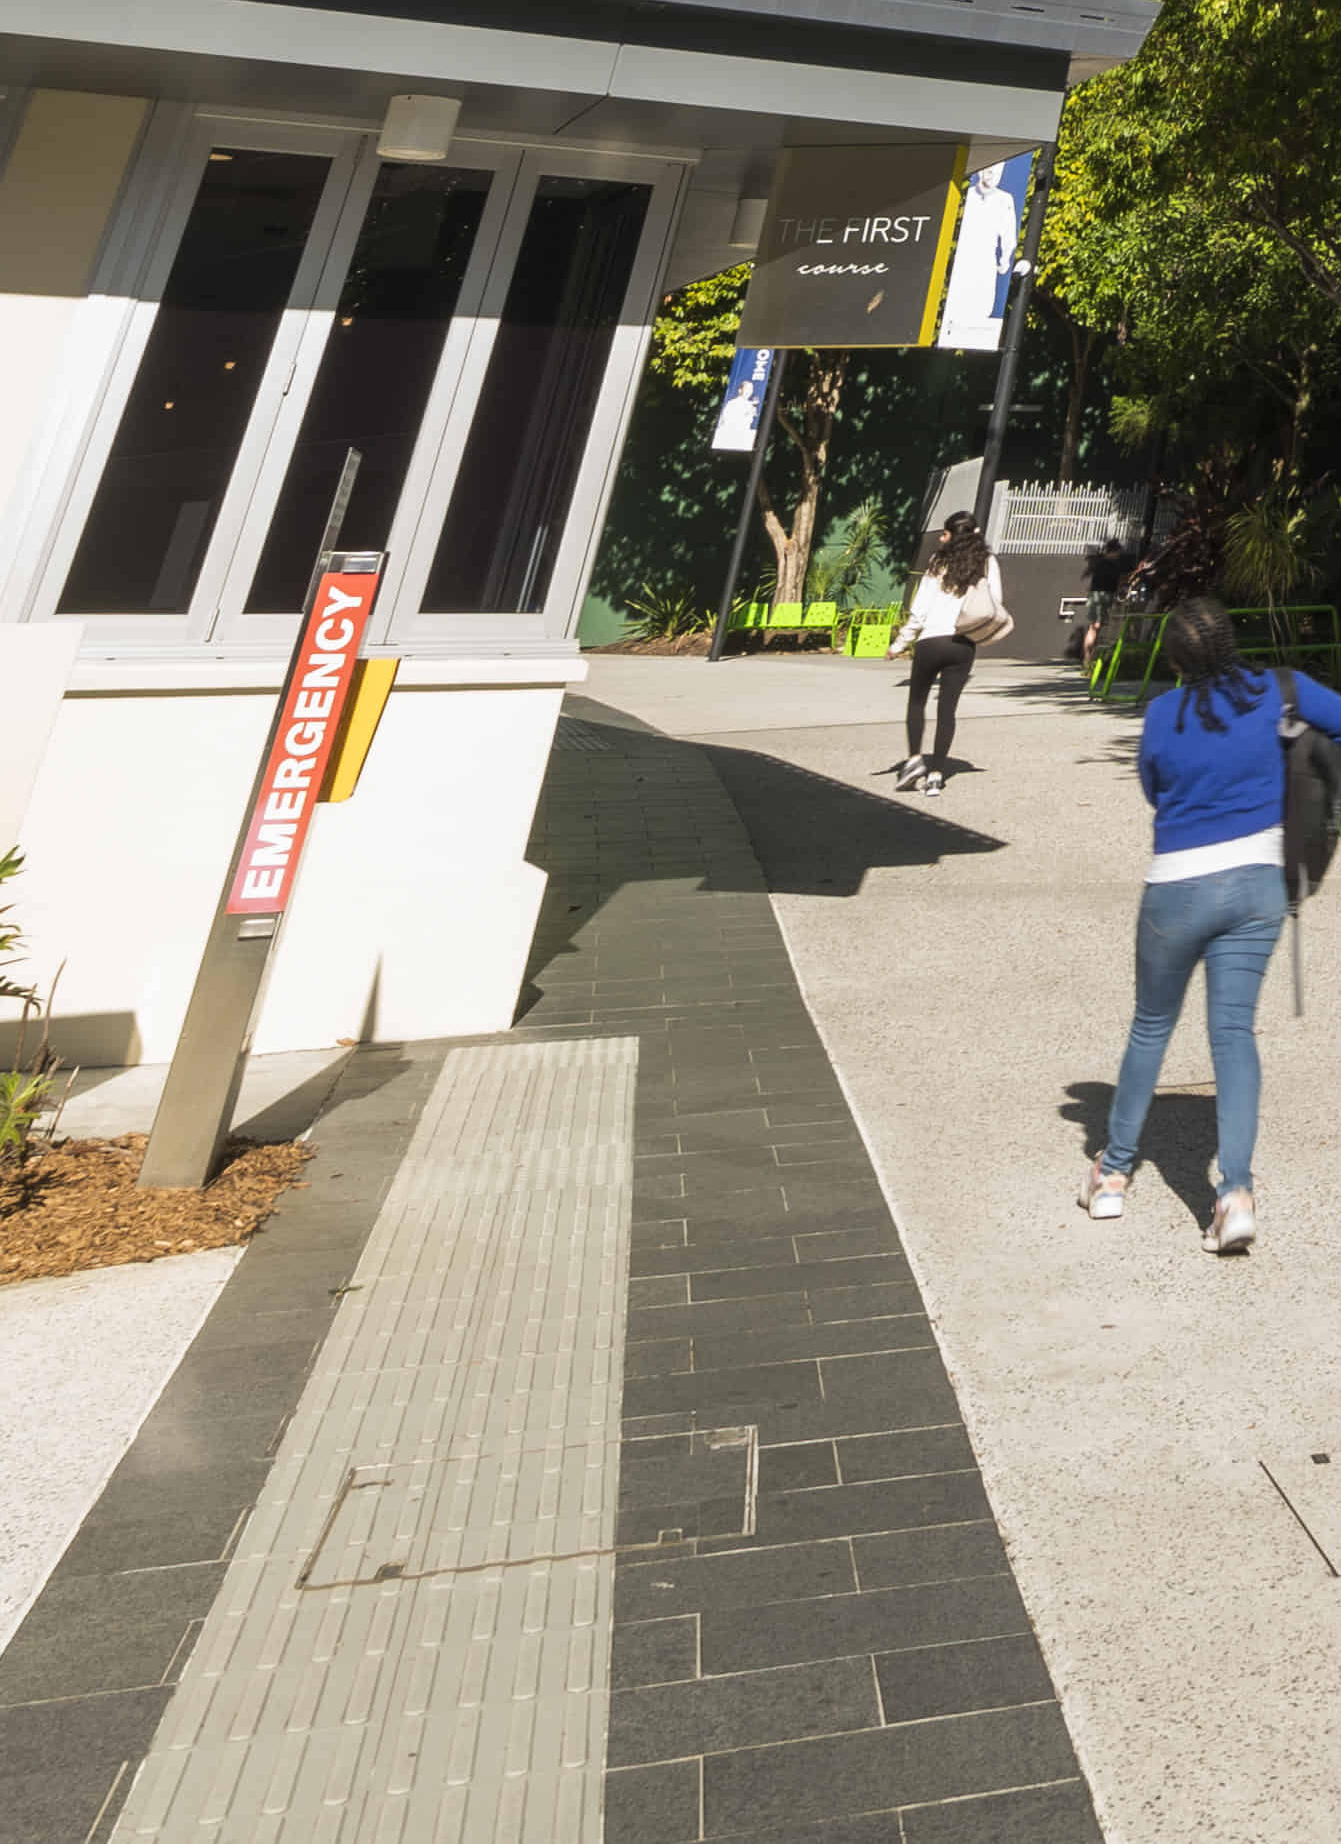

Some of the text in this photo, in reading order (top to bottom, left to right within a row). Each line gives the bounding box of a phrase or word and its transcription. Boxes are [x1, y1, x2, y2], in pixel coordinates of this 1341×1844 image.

[780, 215, 931, 245] THE FIRST
[796, 260, 889, 275] course
[241, 586, 365, 900] EMERGENCY
